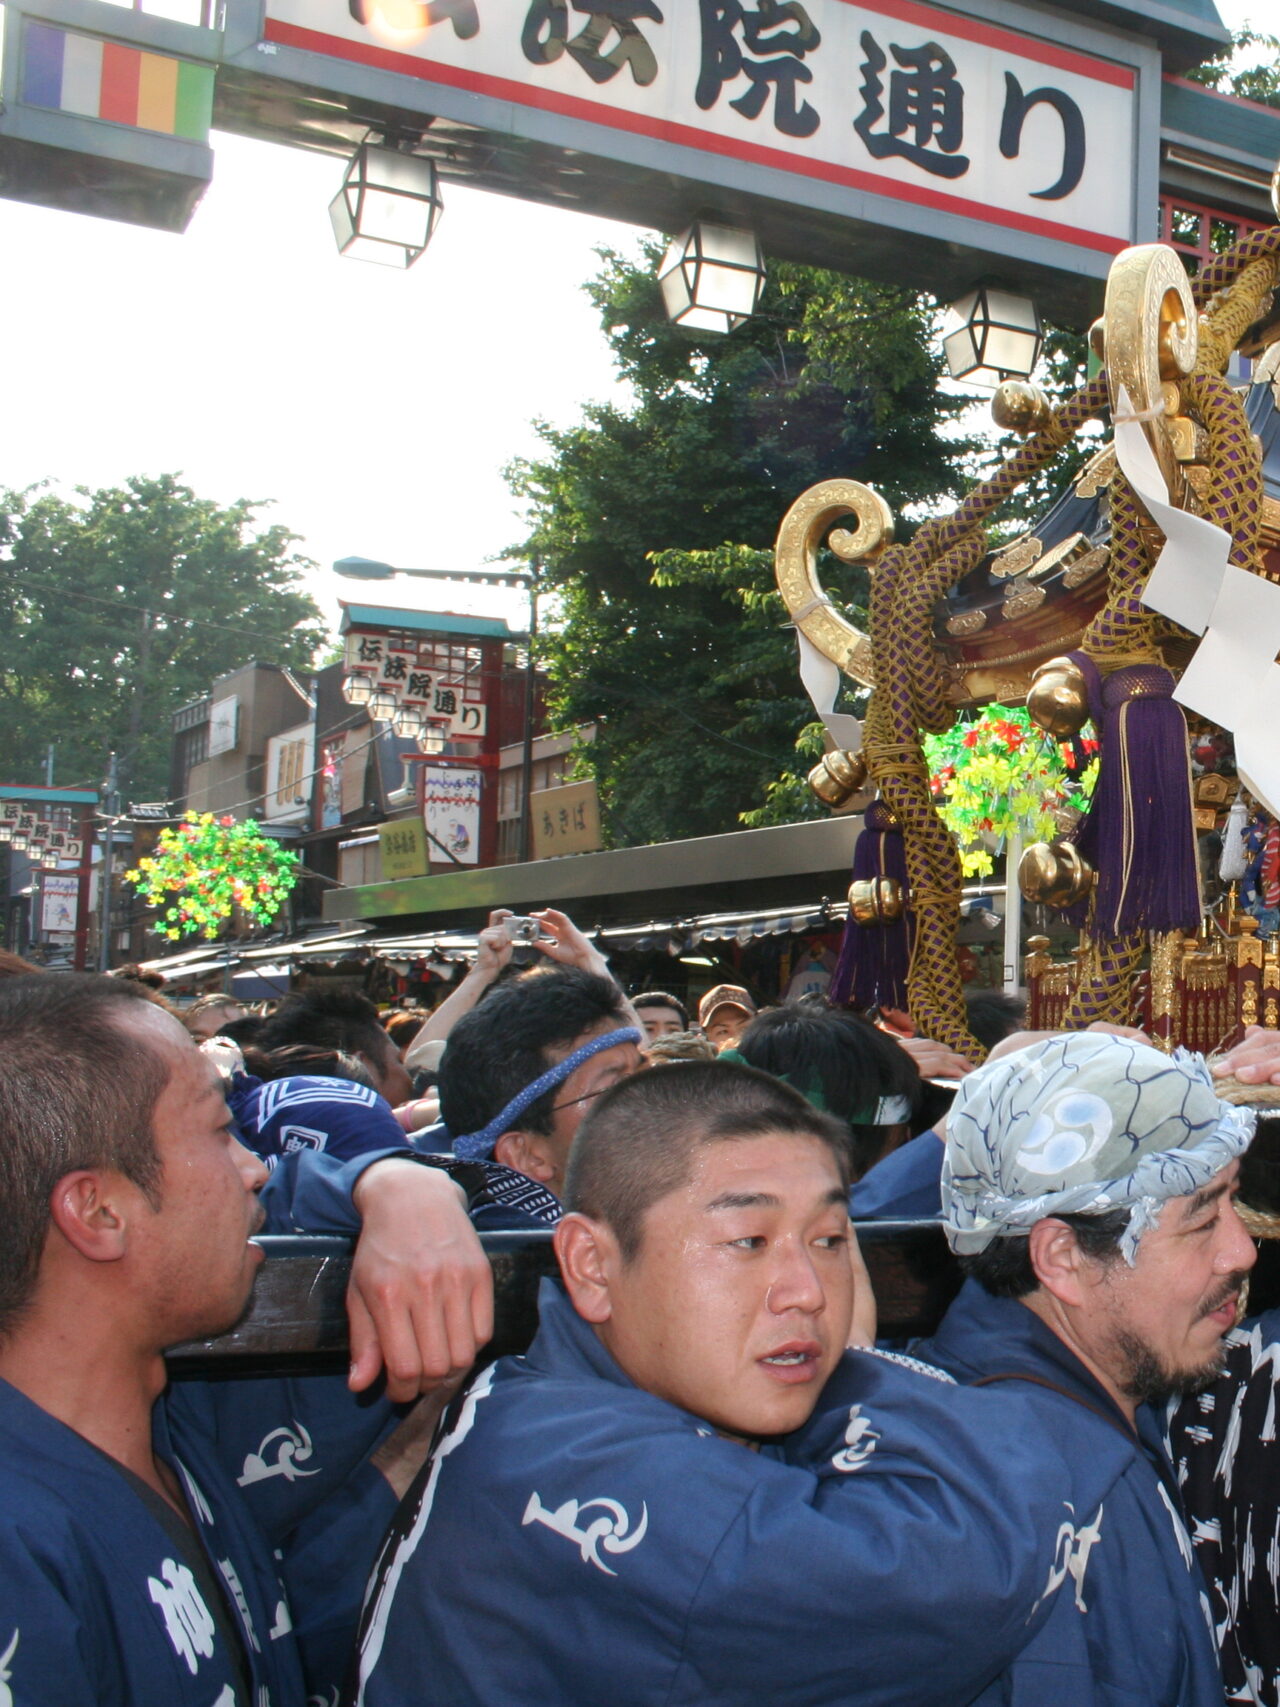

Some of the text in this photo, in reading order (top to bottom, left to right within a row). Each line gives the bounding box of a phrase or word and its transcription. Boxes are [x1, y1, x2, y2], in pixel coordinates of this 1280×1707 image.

[349, 0, 1086, 200] 法院通り
[358, 637, 481, 730] 伝法院通り
[4, 804, 80, 857] 伝法院通り
